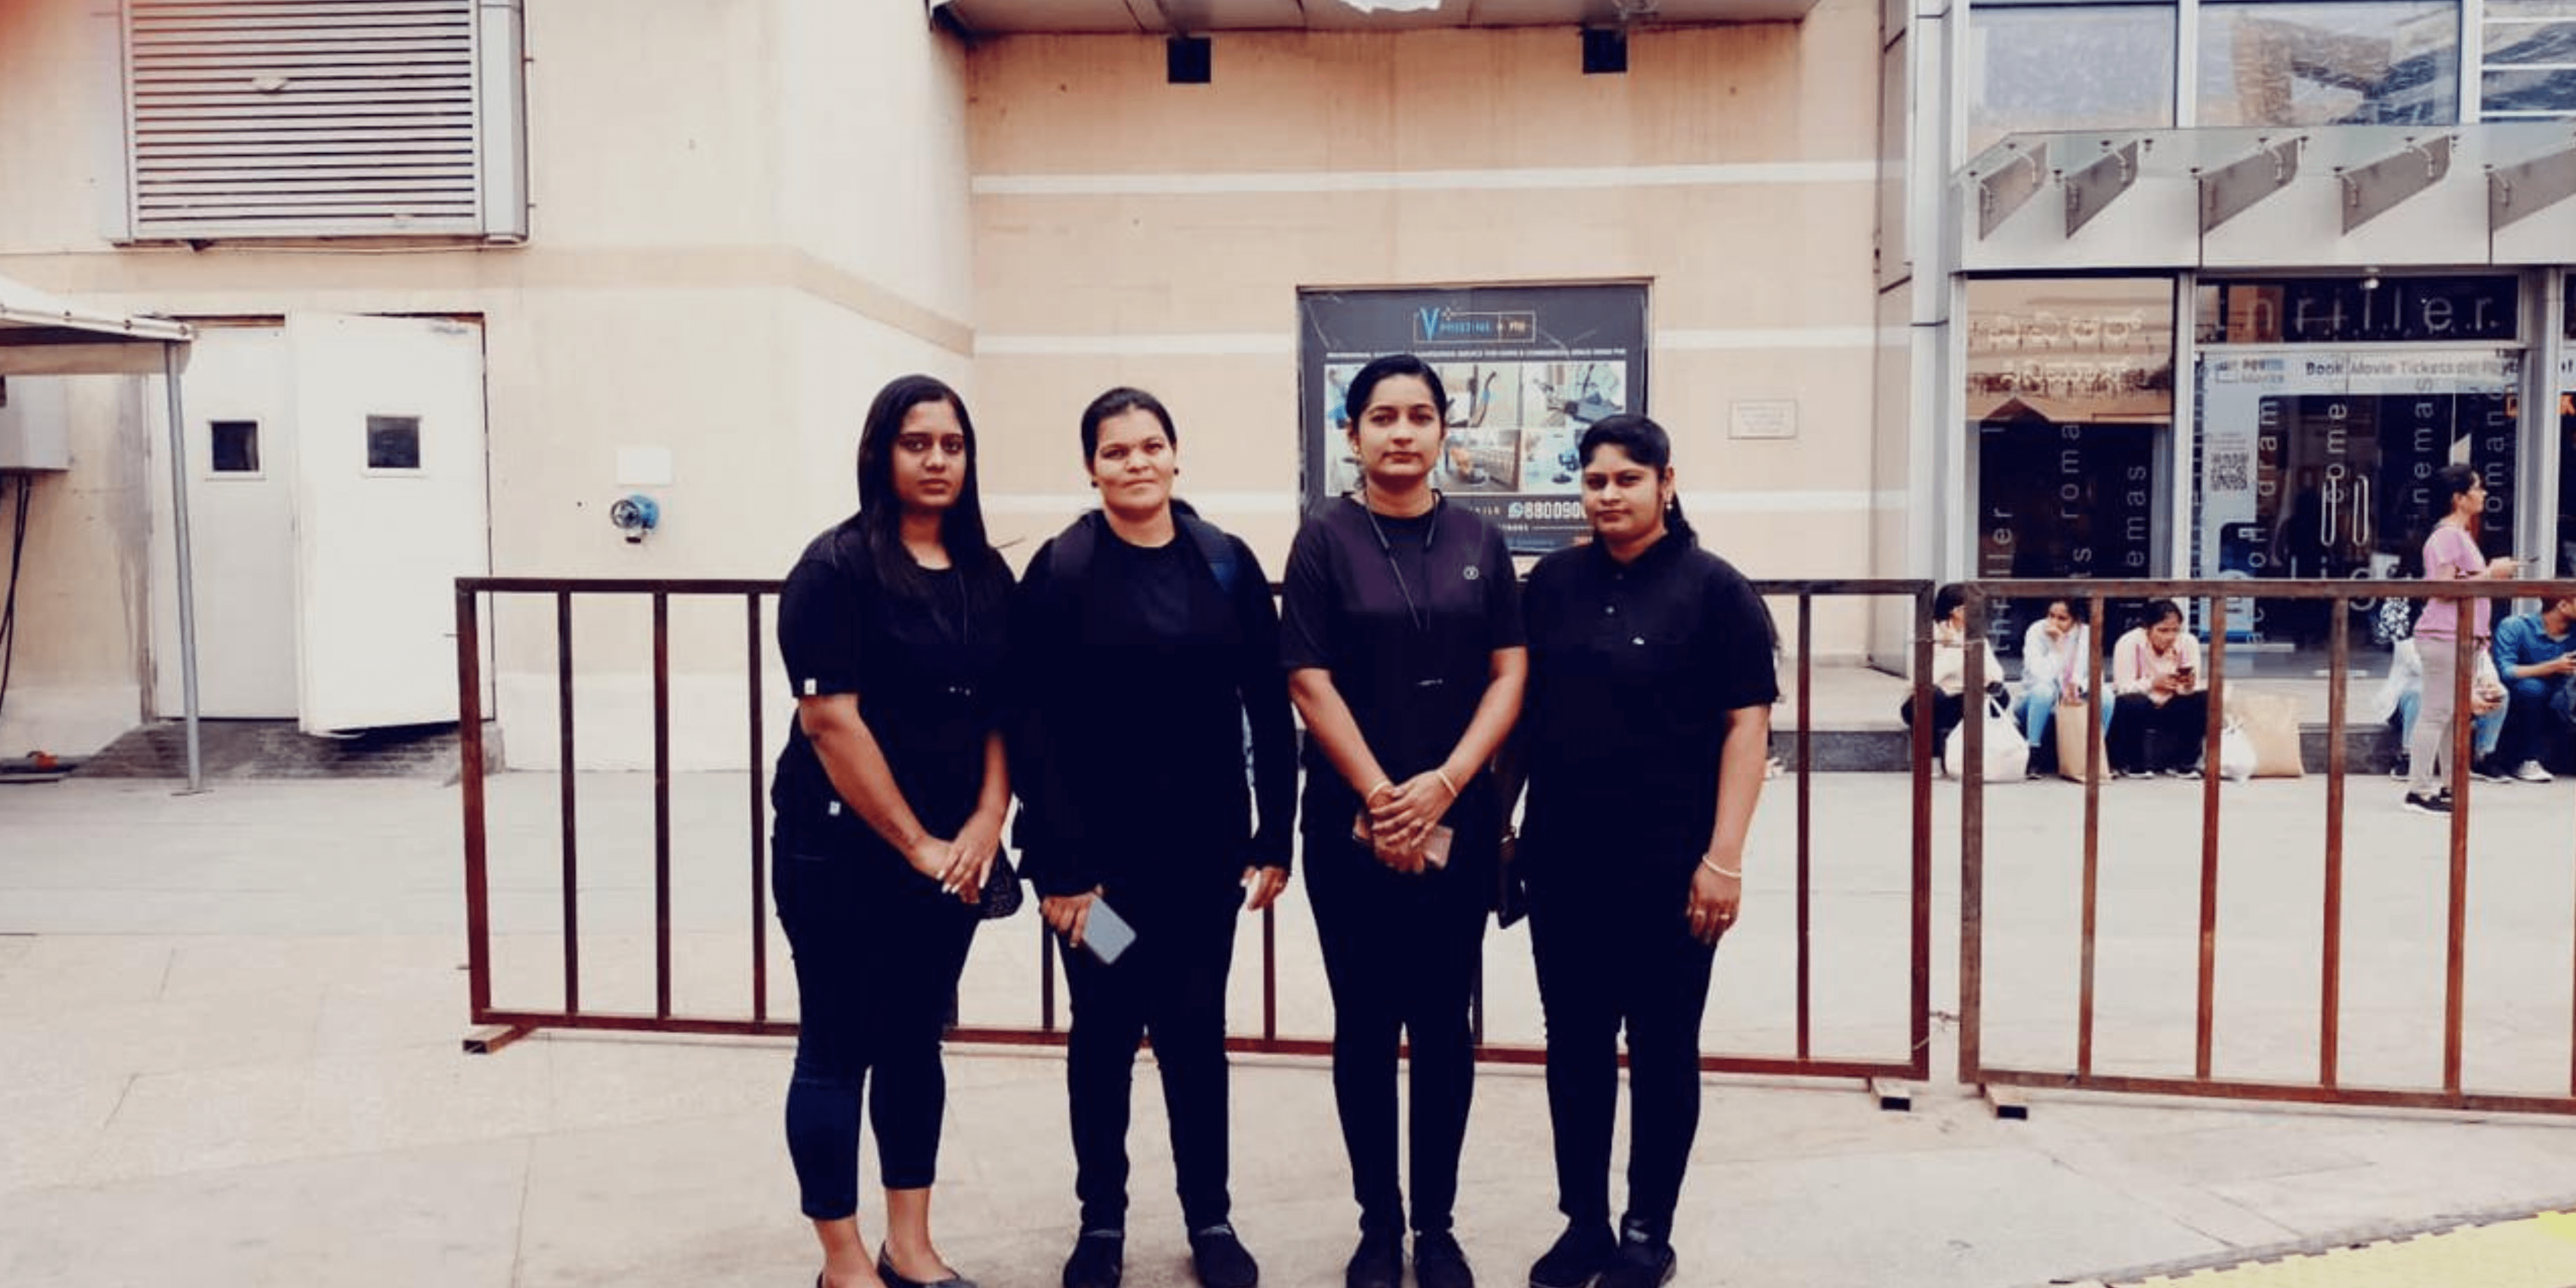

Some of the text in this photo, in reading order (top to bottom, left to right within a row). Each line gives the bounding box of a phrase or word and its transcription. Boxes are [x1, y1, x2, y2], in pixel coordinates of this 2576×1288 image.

[2305, 361, 2343, 376] Book
[1524, 502, 1587, 520] 880090
[1986, 506, 2013, 652] thrller
